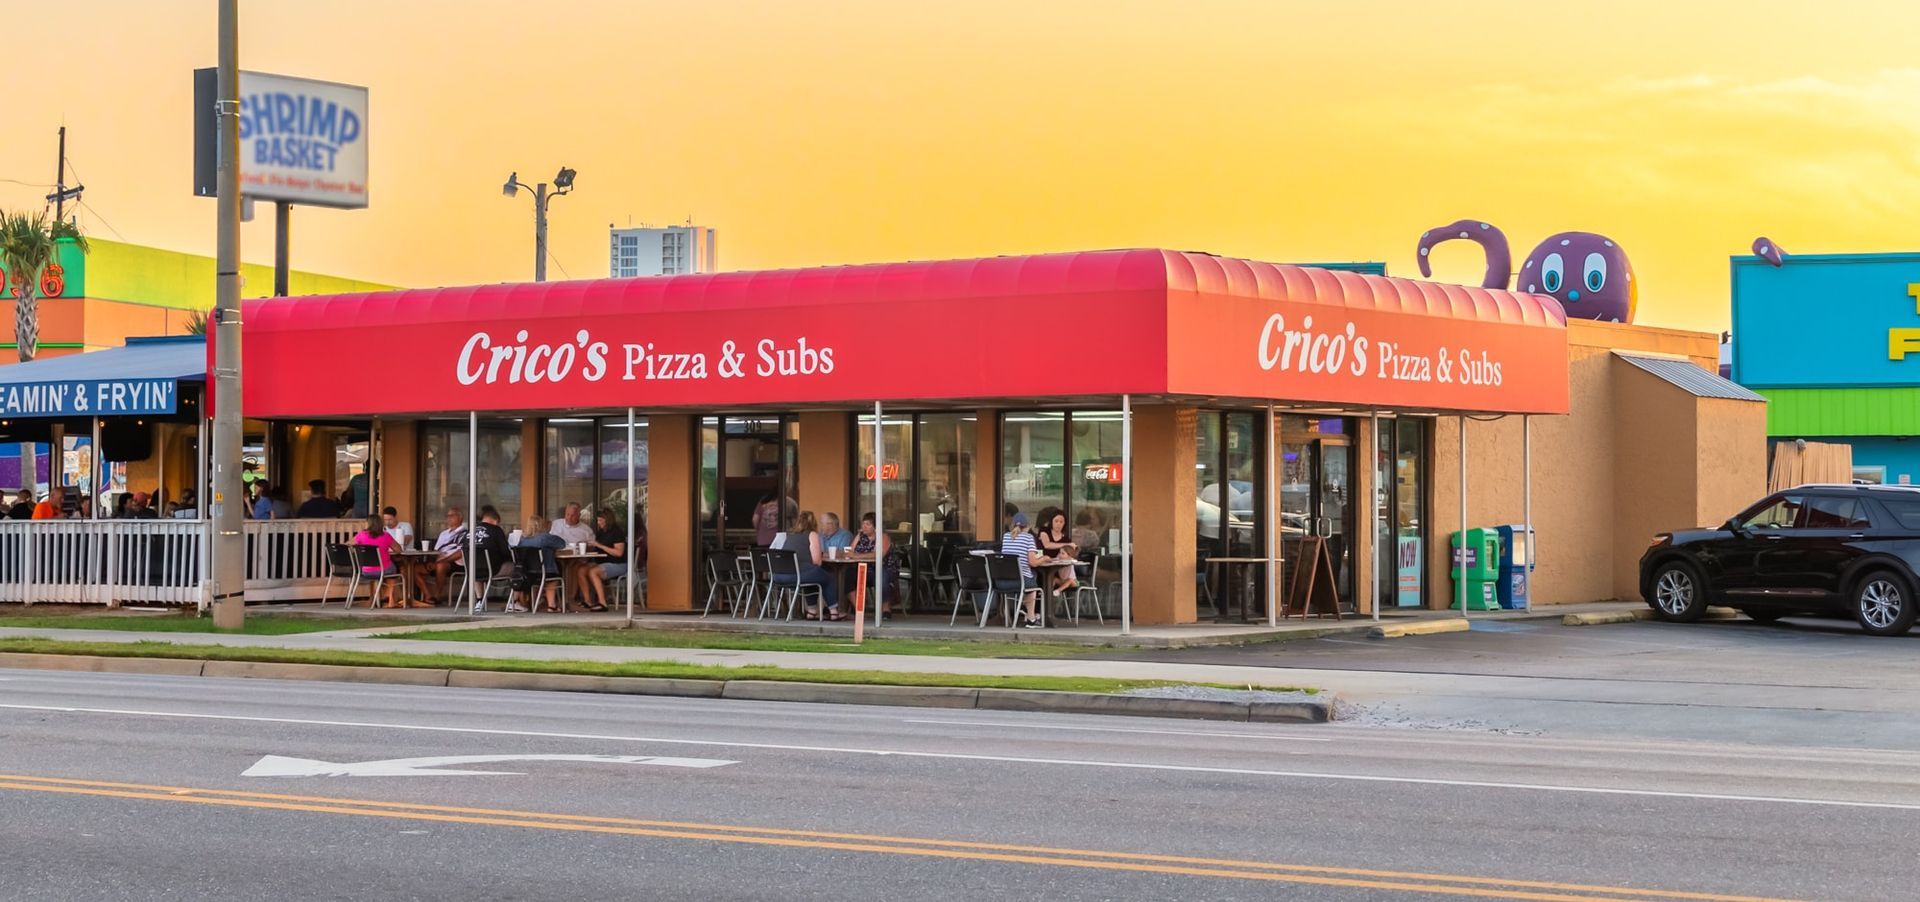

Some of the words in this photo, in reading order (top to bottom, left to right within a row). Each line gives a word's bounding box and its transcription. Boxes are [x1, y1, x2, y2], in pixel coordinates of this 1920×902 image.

[239, 91, 361, 145] SHRIMP
[255, 137, 338, 172] BASKET
[456, 329, 609, 386] Crico's
[622, 342, 707, 381] Pizza
[717, 340, 745, 378] &
[756, 337, 834, 377] Subs
[1258, 312, 1368, 377] Crico's
[1376, 341, 1431, 382] Pizza
[1436, 347, 1453, 383] &
[1459, 348, 1502, 387] Subs
[74, 383, 89, 412] &
[97, 381, 173, 411] FRYIN'
[866, 463, 899, 480] OEN
